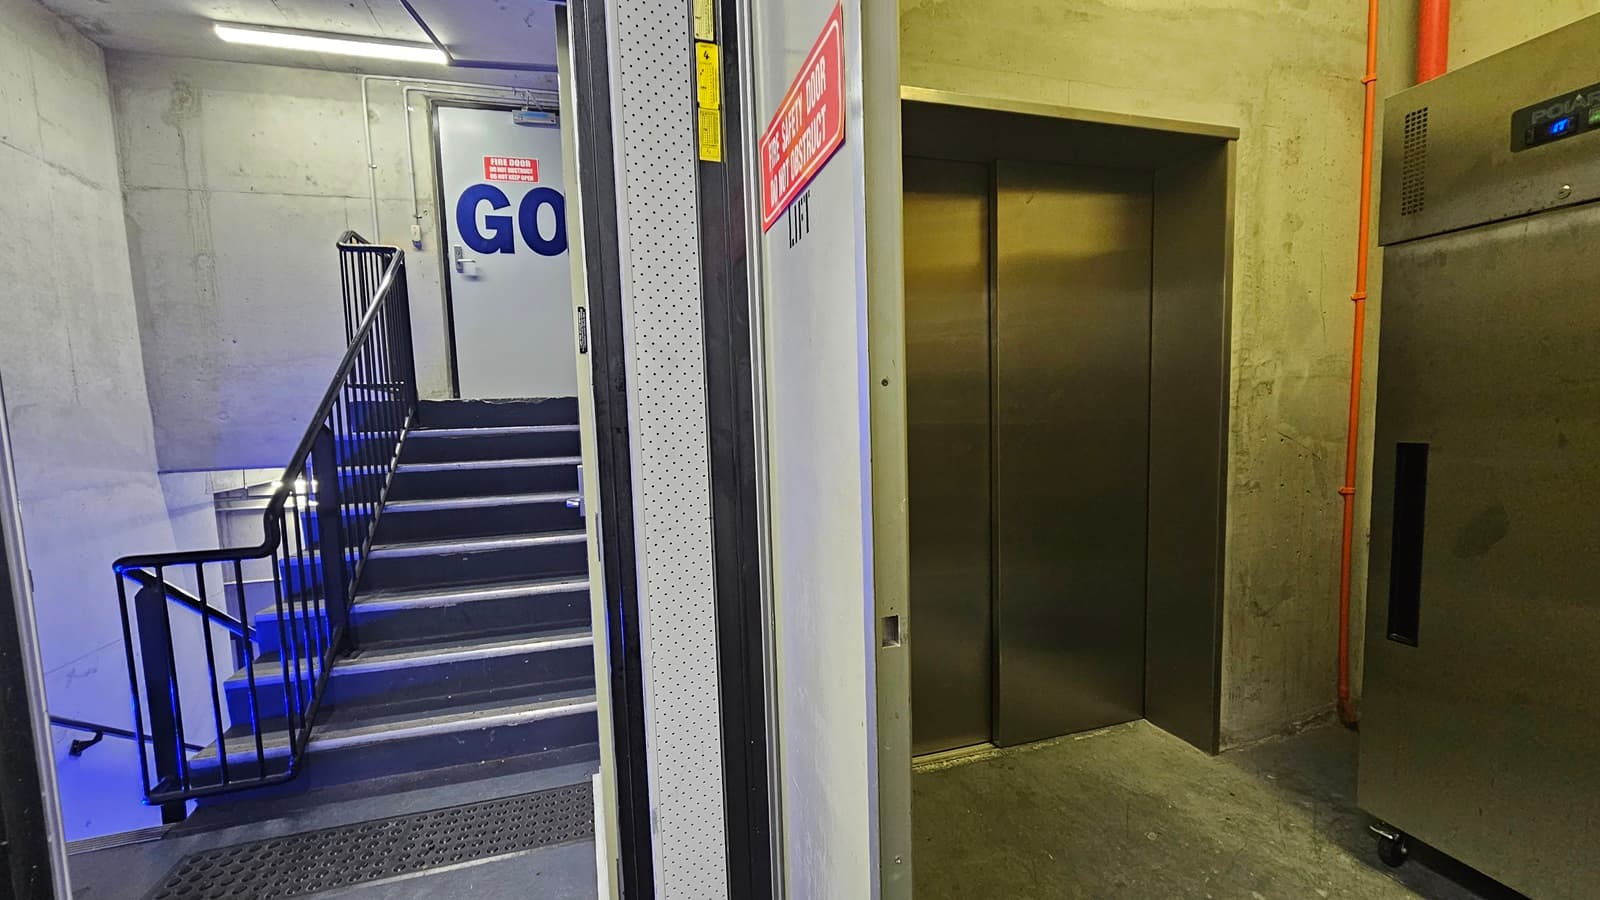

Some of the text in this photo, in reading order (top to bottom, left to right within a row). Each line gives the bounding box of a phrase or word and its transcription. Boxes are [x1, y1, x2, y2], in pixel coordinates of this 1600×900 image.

[769, 55, 826, 173] FIRE SAFETY DOOR
[490, 158, 531, 168] FIRE DOOR
[770, 103, 827, 209] DO NOT OBSTRUCT
[456, 183, 568, 256] GO
[788, 190, 810, 249] LIFT
